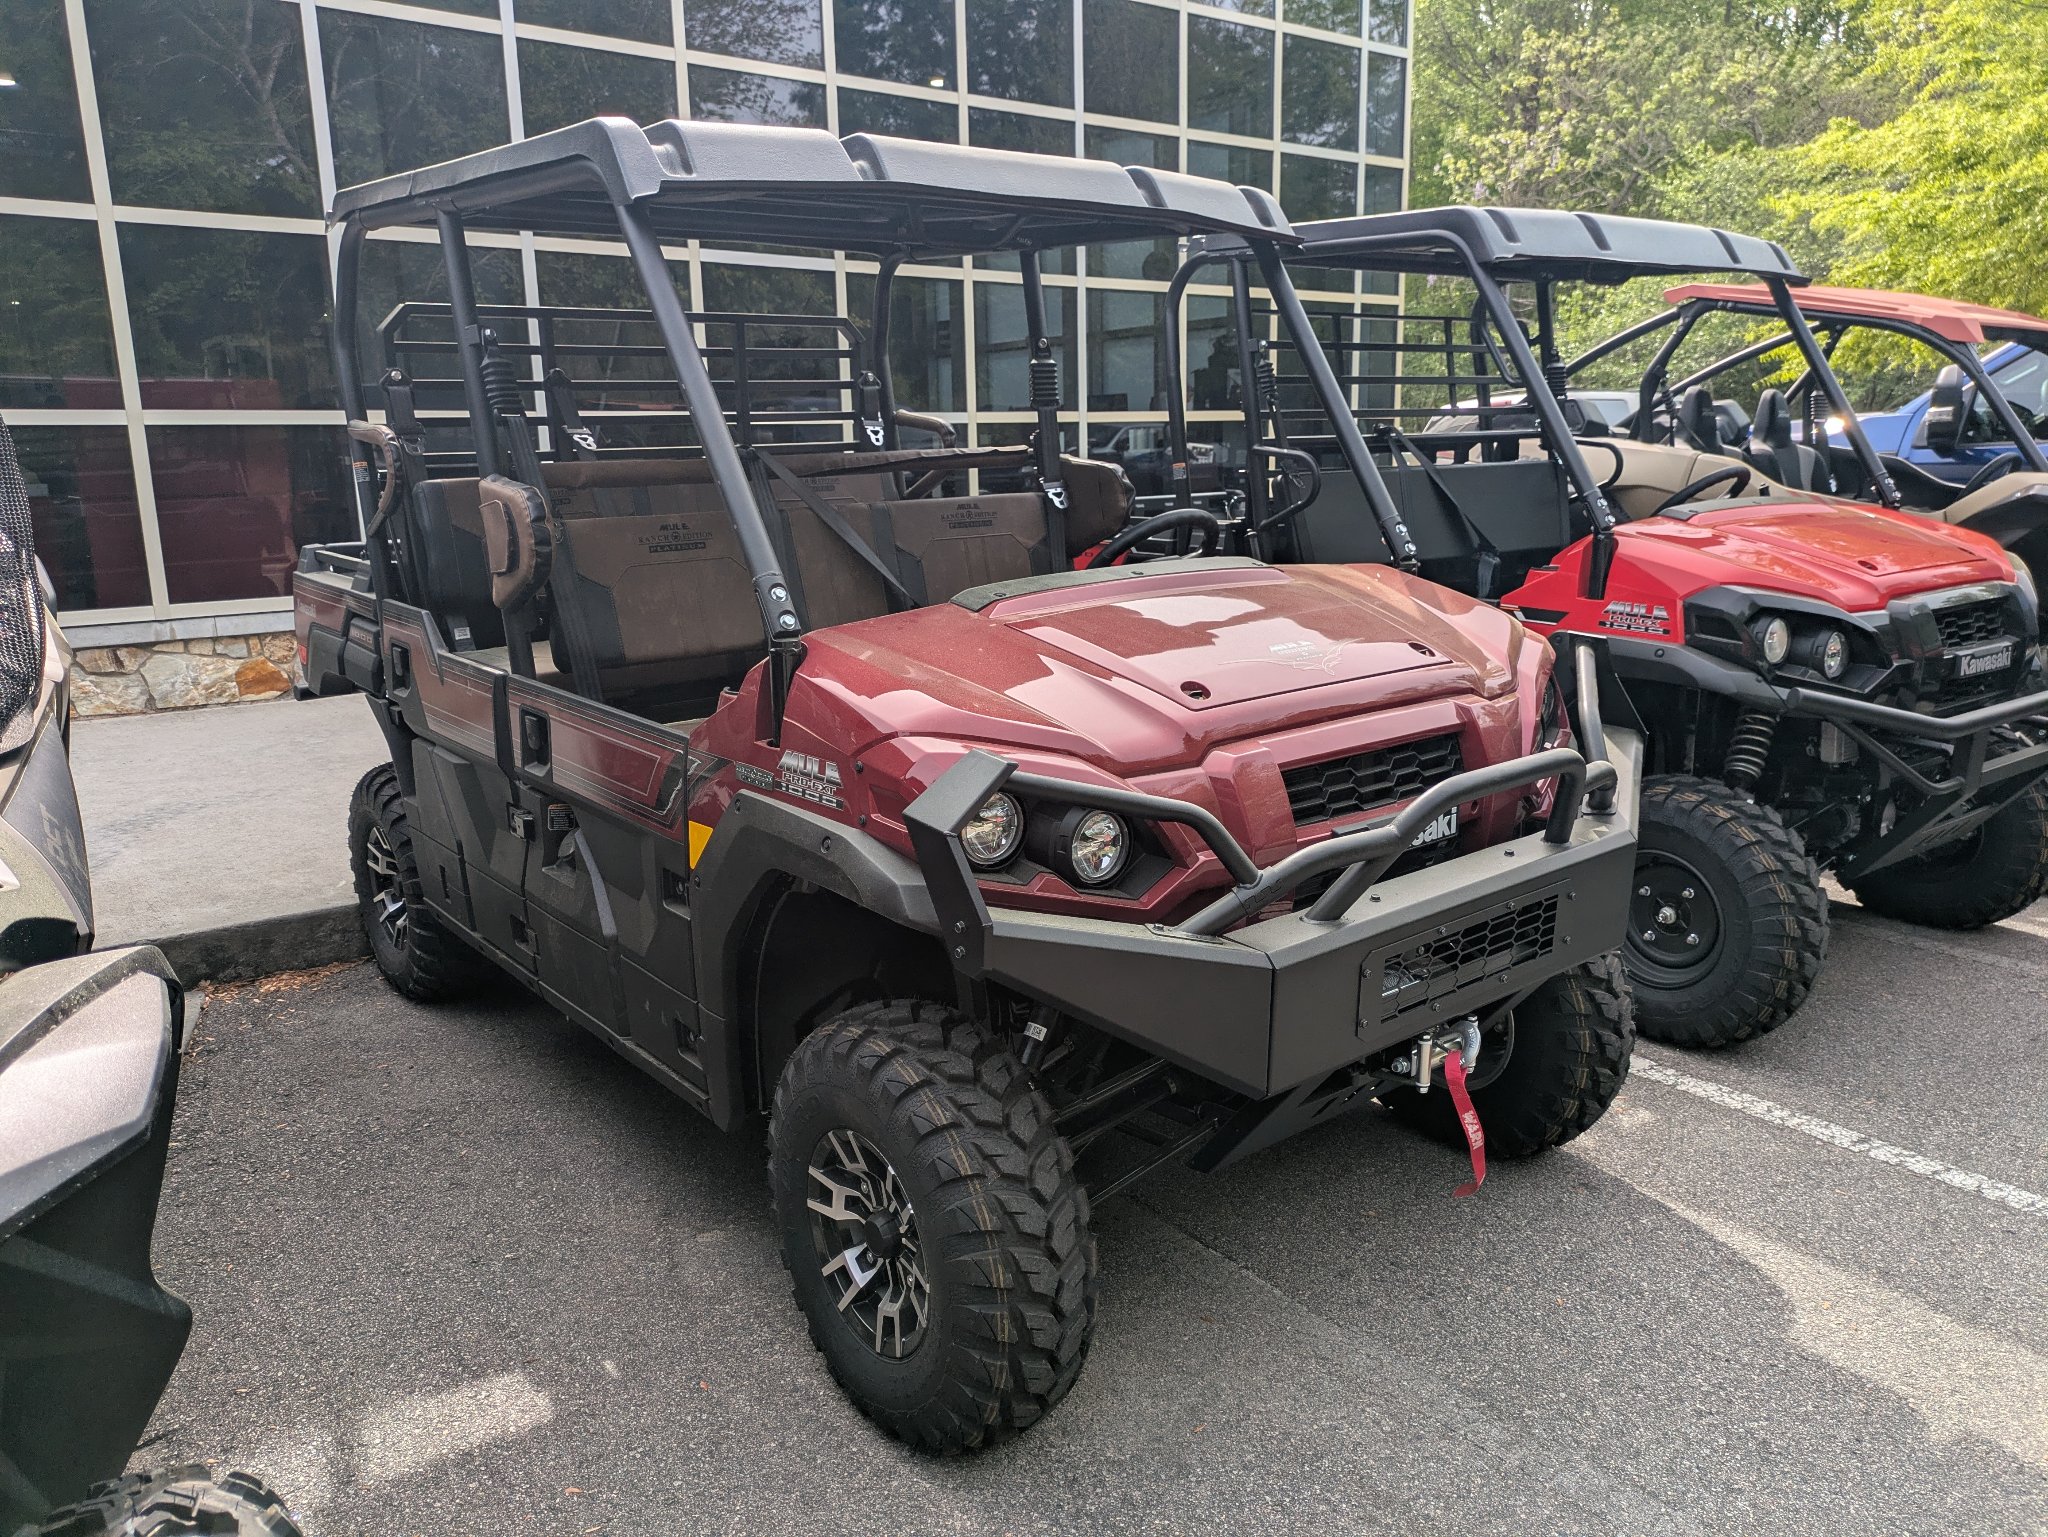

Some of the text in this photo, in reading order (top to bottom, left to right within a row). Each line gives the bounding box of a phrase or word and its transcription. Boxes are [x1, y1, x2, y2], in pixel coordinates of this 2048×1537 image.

[638, 531, 713, 544] RANCH EDITION
[659, 522, 690, 531] MULE
[650, 541, 706, 553] PLATINUM
[1602, 601, 1670, 621] MULE
[1960, 646, 2012, 676] Kawasaki
[777, 749, 843, 788] MULE
[780, 782, 838, 808] 1000
[1462, 1110, 1484, 1150] WARN
